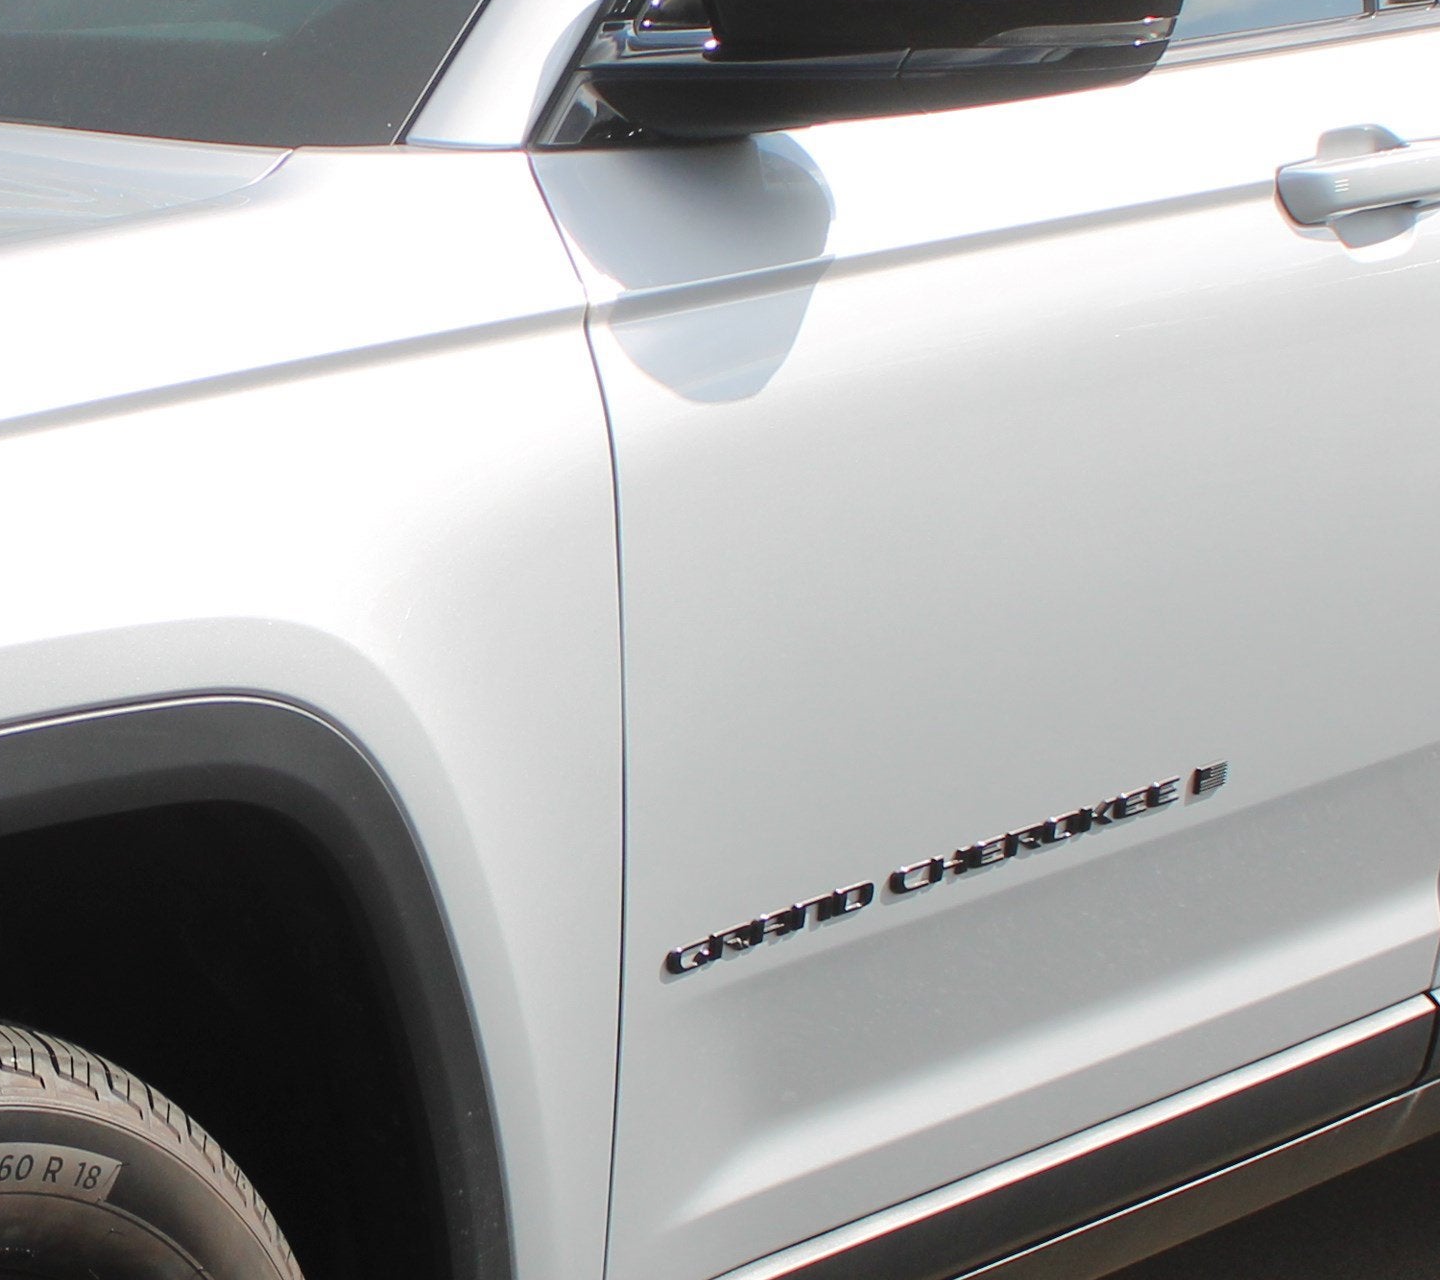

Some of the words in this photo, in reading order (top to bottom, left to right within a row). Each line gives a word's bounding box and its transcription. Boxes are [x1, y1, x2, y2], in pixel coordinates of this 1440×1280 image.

[665, 881, 874, 974] GRAND
[890, 775, 1181, 893] CHEROKEE
[42, 1156, 64, 1182] R
[74, 1161, 102, 1191] 18
